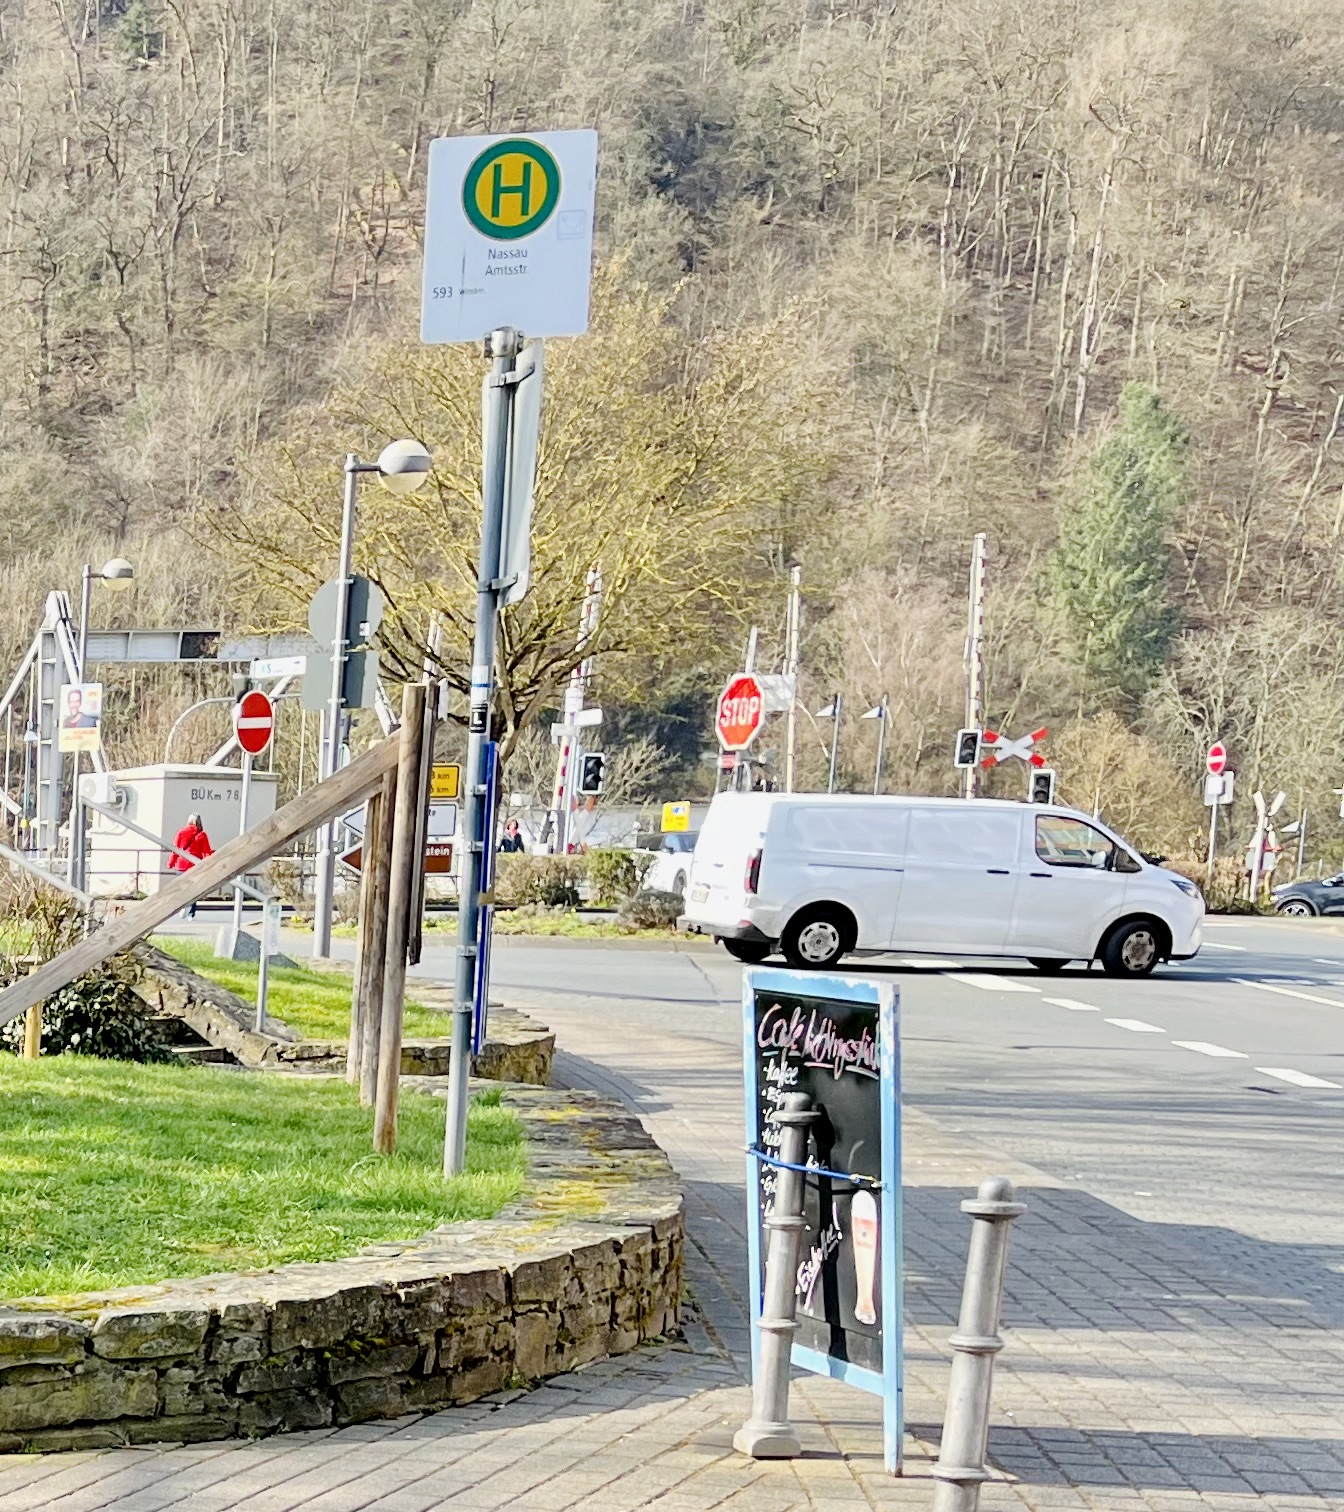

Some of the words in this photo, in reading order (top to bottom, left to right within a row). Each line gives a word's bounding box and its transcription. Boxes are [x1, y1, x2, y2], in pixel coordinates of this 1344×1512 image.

[491, 161, 532, 218] H
[487, 248, 528, 260] Nassau
[432, 286, 453, 299] 593
[720, 695, 759, 728] STOP
